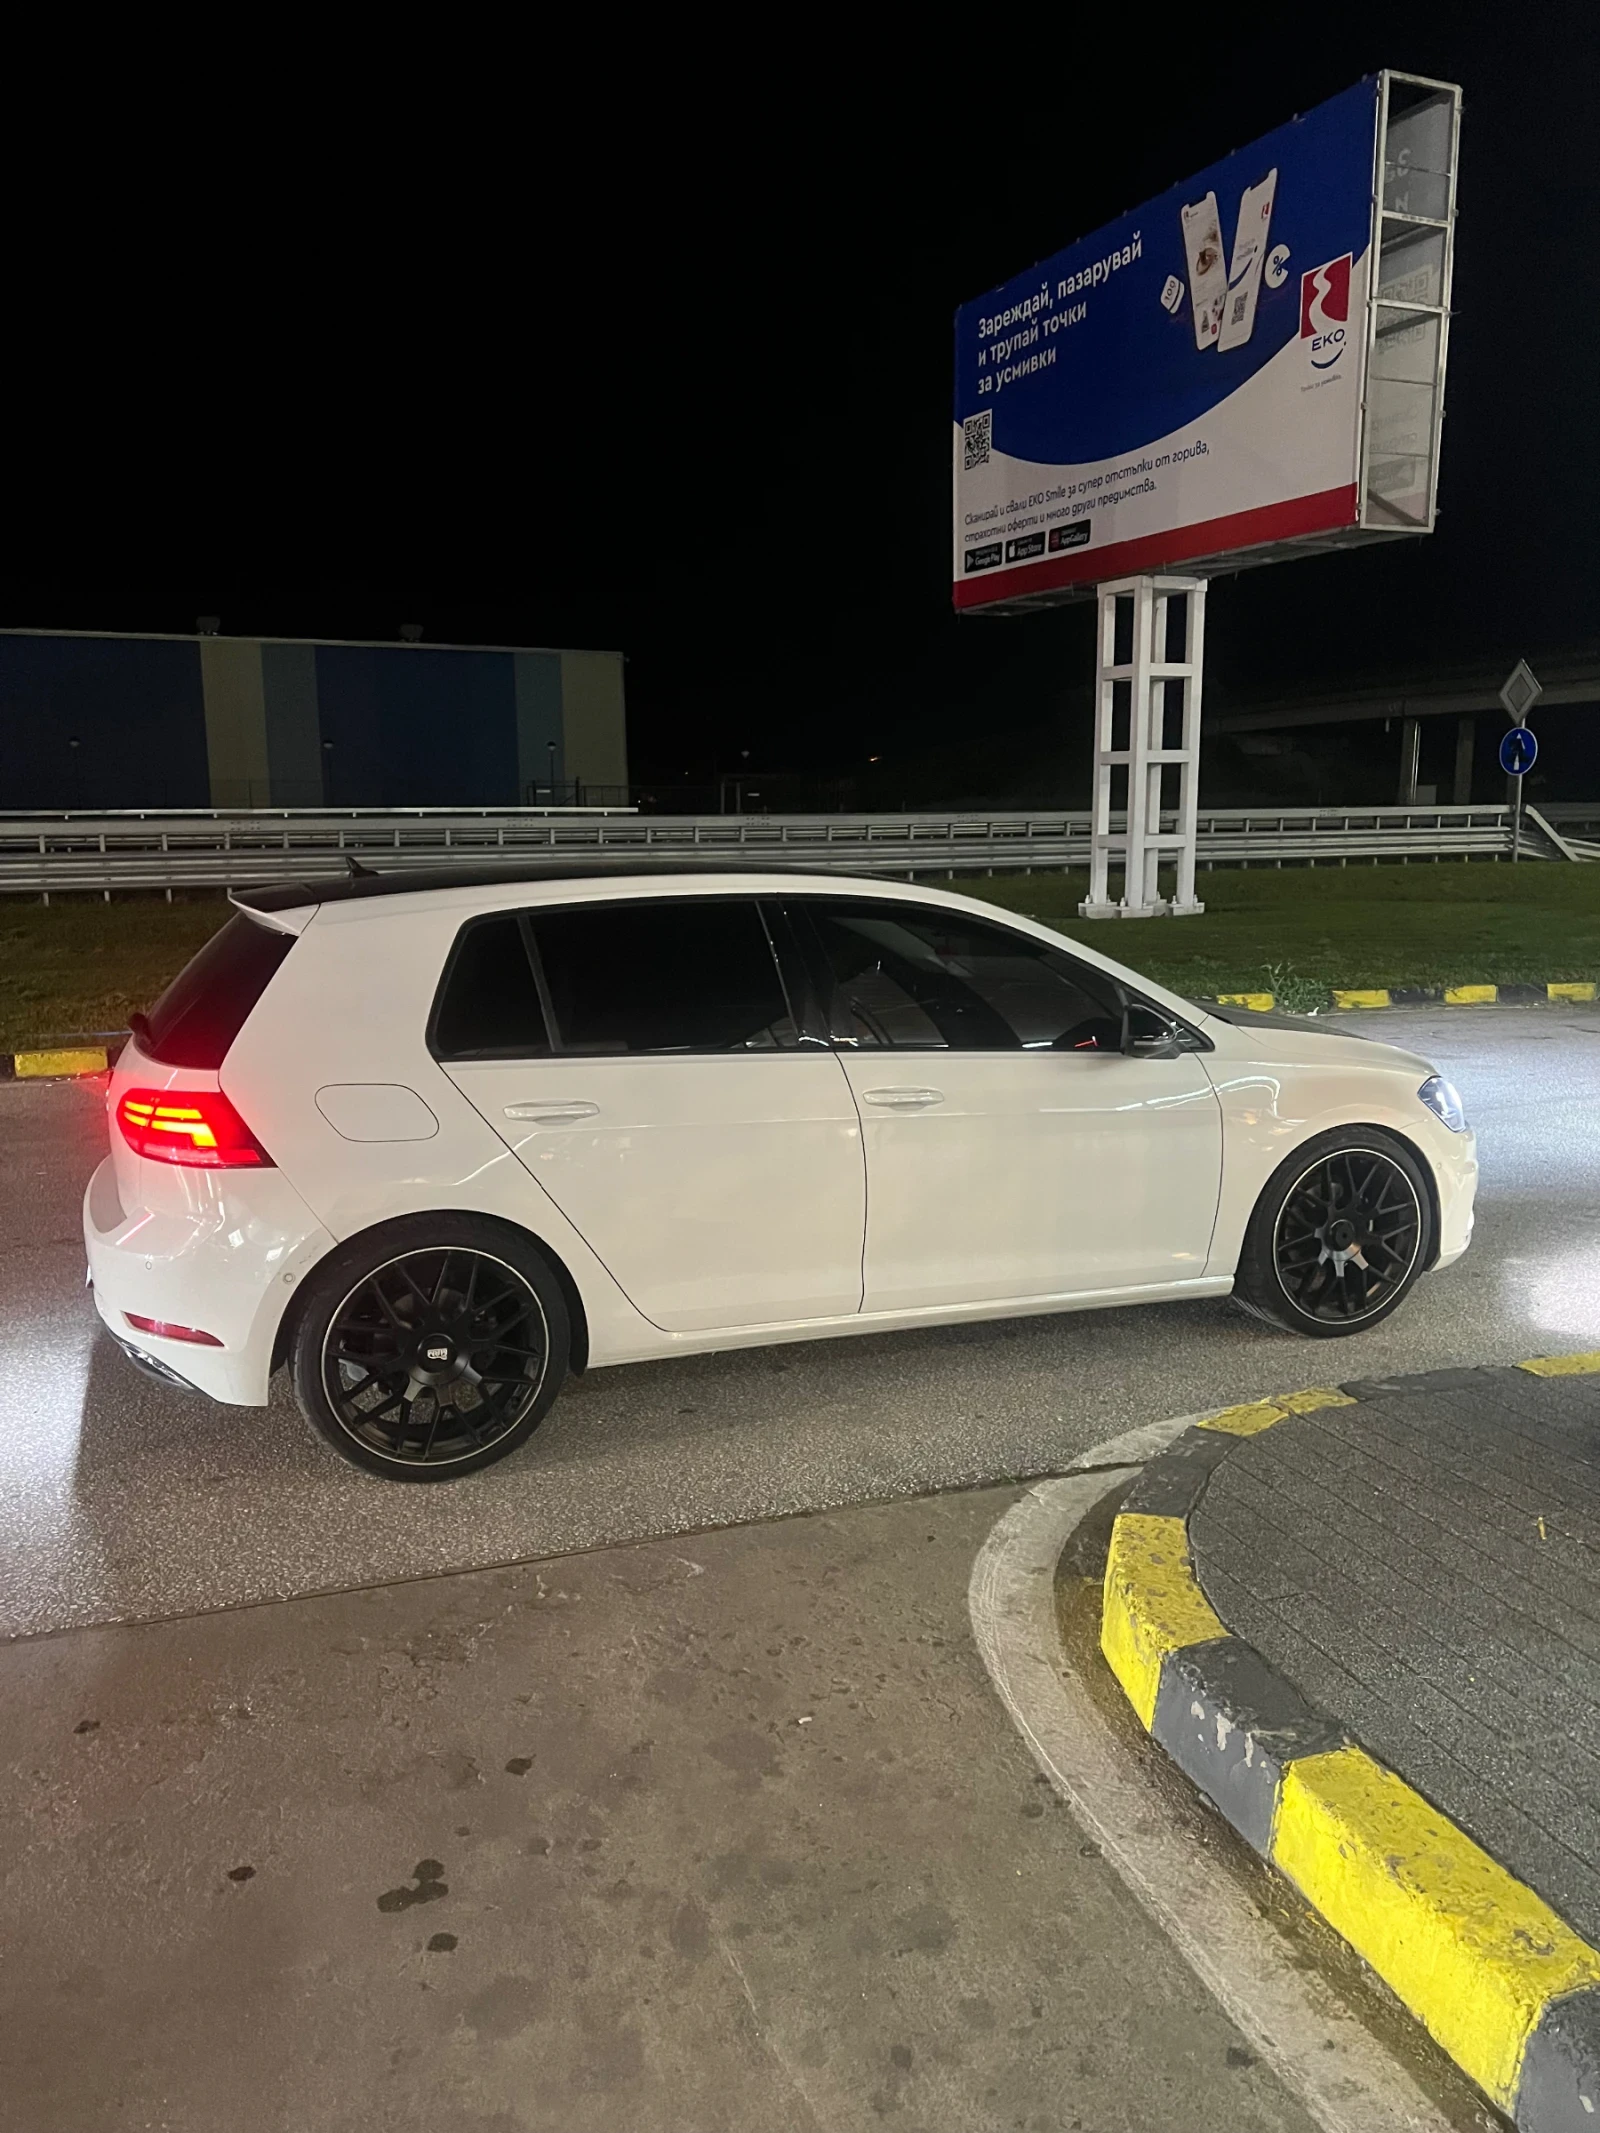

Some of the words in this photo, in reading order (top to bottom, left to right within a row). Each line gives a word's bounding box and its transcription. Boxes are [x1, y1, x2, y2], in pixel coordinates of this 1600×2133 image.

[978, 281, 1053, 338] Зареждай,
[1058, 230, 1142, 300] пазарувай
[1164, 280, 1176, 301] 100
[978, 350, 986, 367] и
[990, 317, 1039, 364] трупай
[1043, 301, 1087, 337] точки
[1311, 328, 1345, 352] EKO
[977, 375, 993, 395] за
[995, 347, 1057, 392] усмивки
[964, 504, 999, 525] Сканирай
[999, 508, 1006, 516] и
[1005, 499, 1027, 514] свали
[1028, 492, 1045, 507] EKO
[1045, 484, 1066, 502] Smile
[1067, 484, 1077, 499] за
[1078, 476, 1103, 494] супер
[1104, 458, 1153, 484] отстъпки
[1154, 455, 1170, 468] от
[1172, 440, 1210, 463] горива,
[964, 524, 1006, 543] страхотни
[1007, 515, 1038, 532] оферти
[1039, 514, 1045, 523] и
[1046, 506, 1070, 520] много
[1071, 498, 1096, 517] други
[1097, 477, 1157, 508] предимства.
